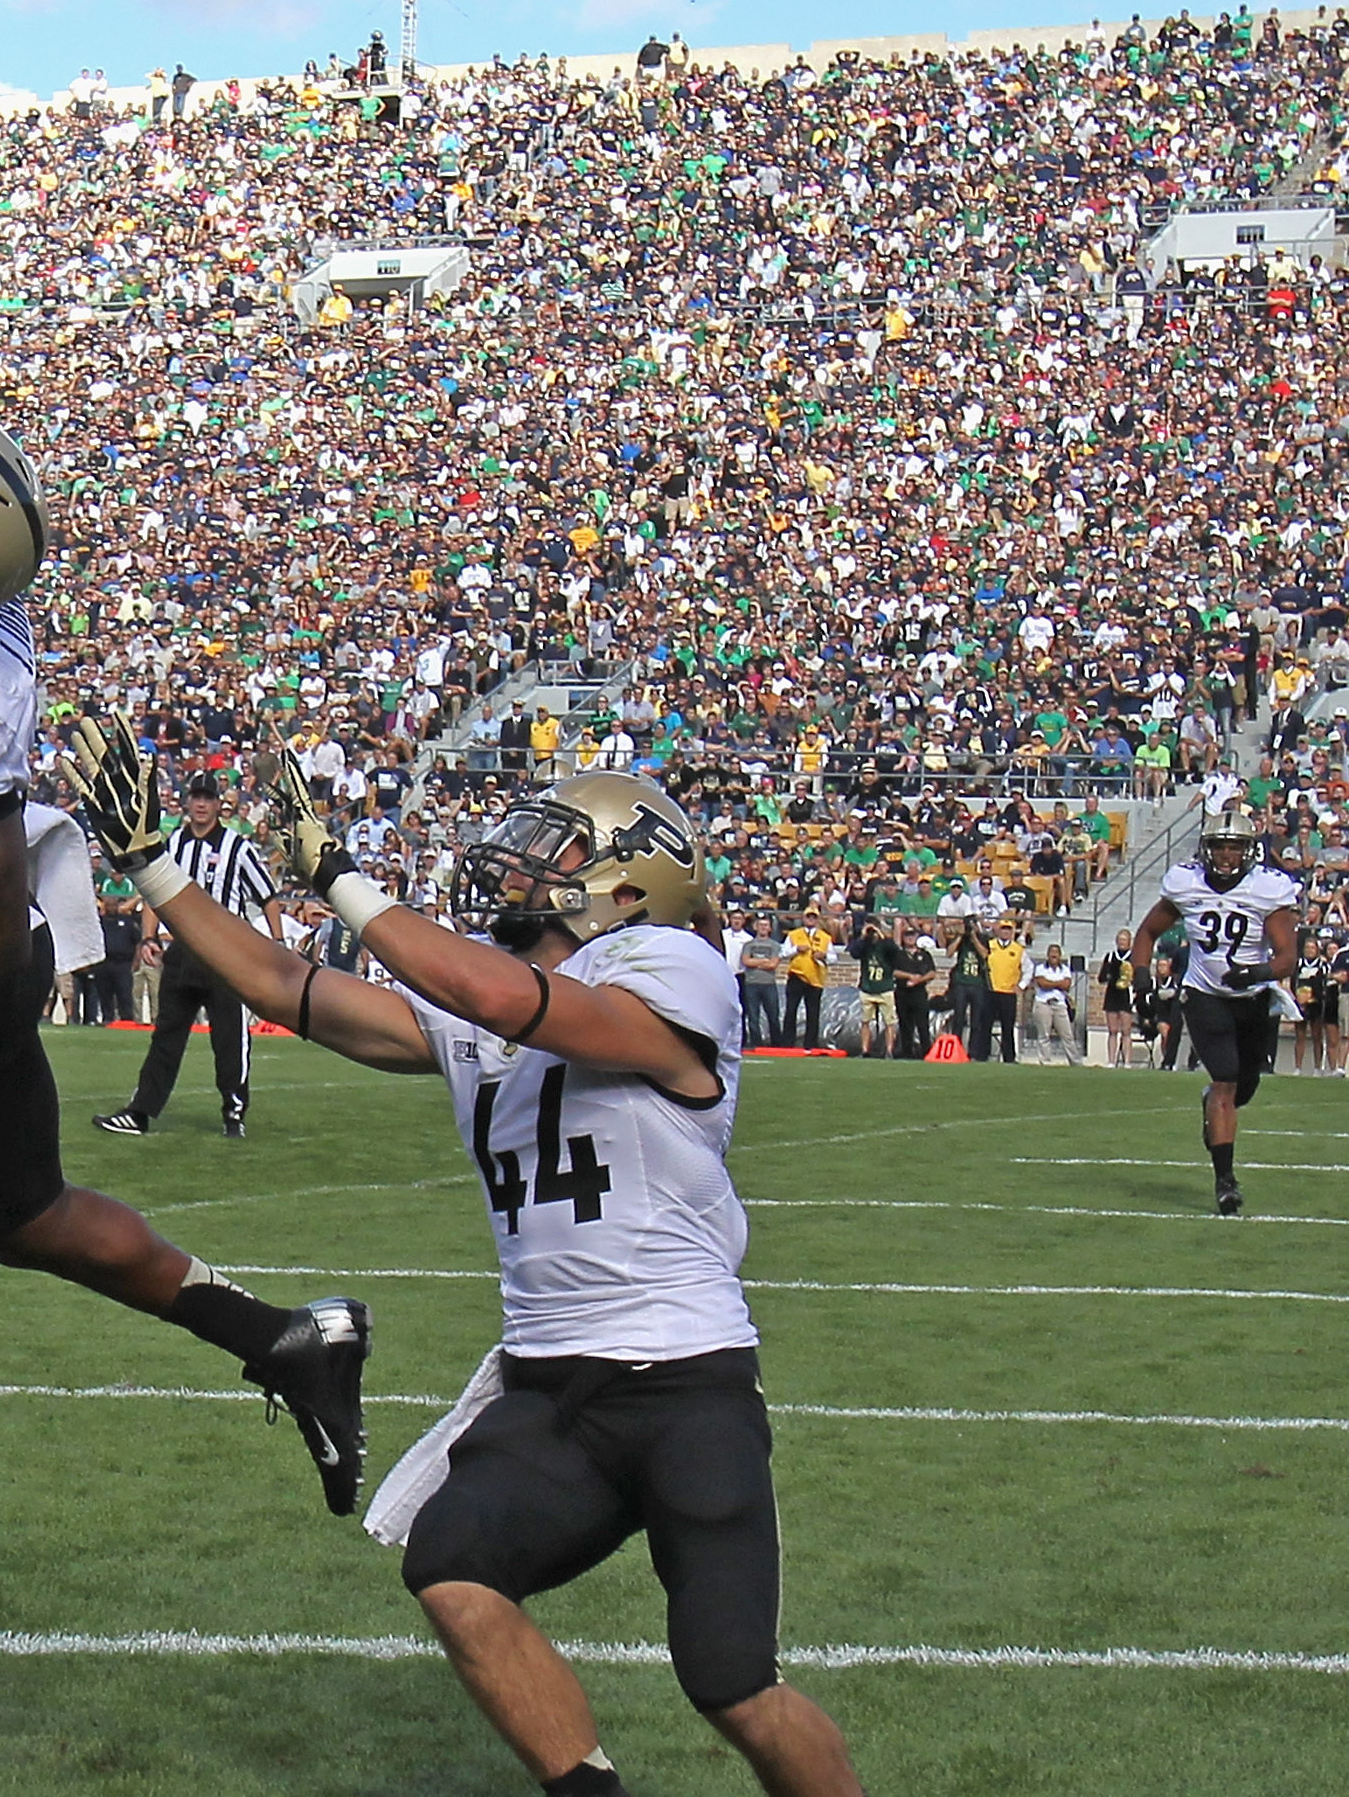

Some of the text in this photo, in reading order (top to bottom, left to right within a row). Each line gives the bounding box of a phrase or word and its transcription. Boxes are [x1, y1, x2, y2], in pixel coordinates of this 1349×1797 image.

[1199, 911, 1249, 960] 39
[936, 1039, 955, 1060] 10
[472, 1062, 611, 1236] 44
